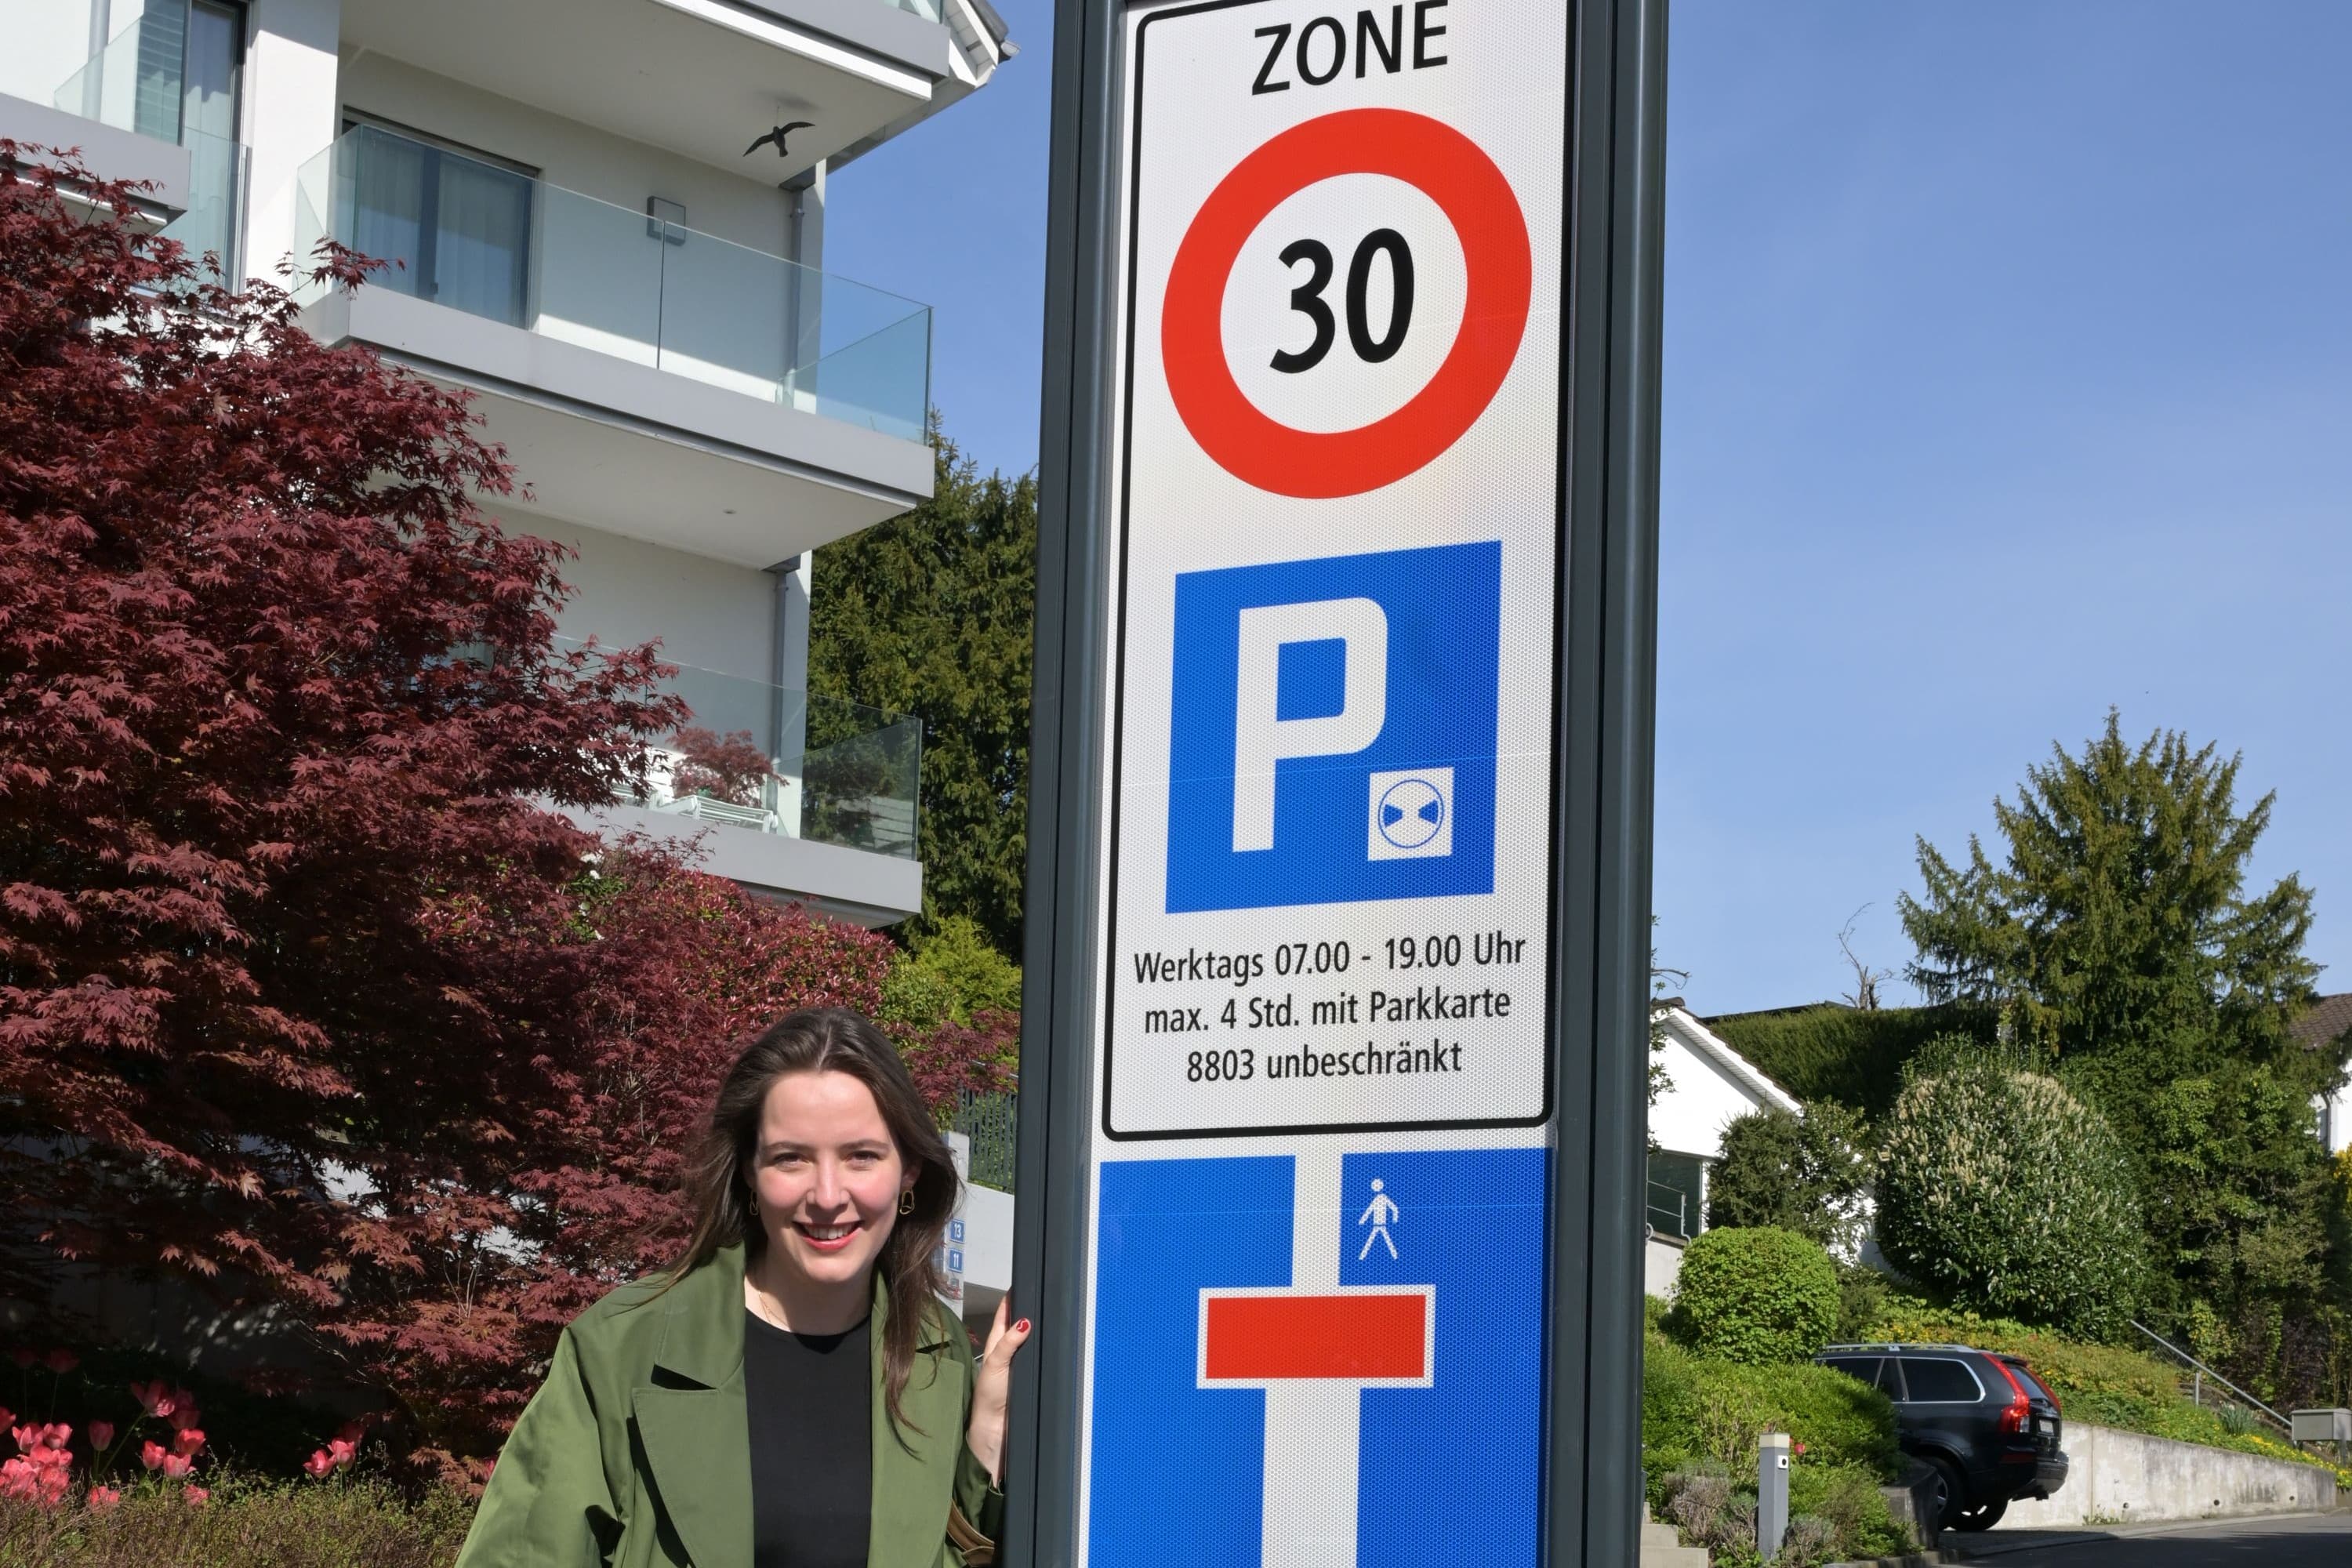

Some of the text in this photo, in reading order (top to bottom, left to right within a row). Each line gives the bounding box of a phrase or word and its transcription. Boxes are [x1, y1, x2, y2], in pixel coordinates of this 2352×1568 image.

[1251, 0, 1448, 95] ZONE
[1269, 227, 1414, 374] 30
[1232, 597, 1388, 852] P
[1134, 948, 1264, 987] Werktags
[1275, 941, 1350, 975] 07.00
[1385, 935, 1461, 970] 19.00
[1474, 931, 1526, 965] Uhr
[1145, 985, 1511, 1033] max. 4 Std. mit Parkkarte
[1187, 1038, 1462, 1082] 8803 unbeschränkt
[954, 1223, 962, 1239] 13
[953, 1253, 960, 1269] 11
